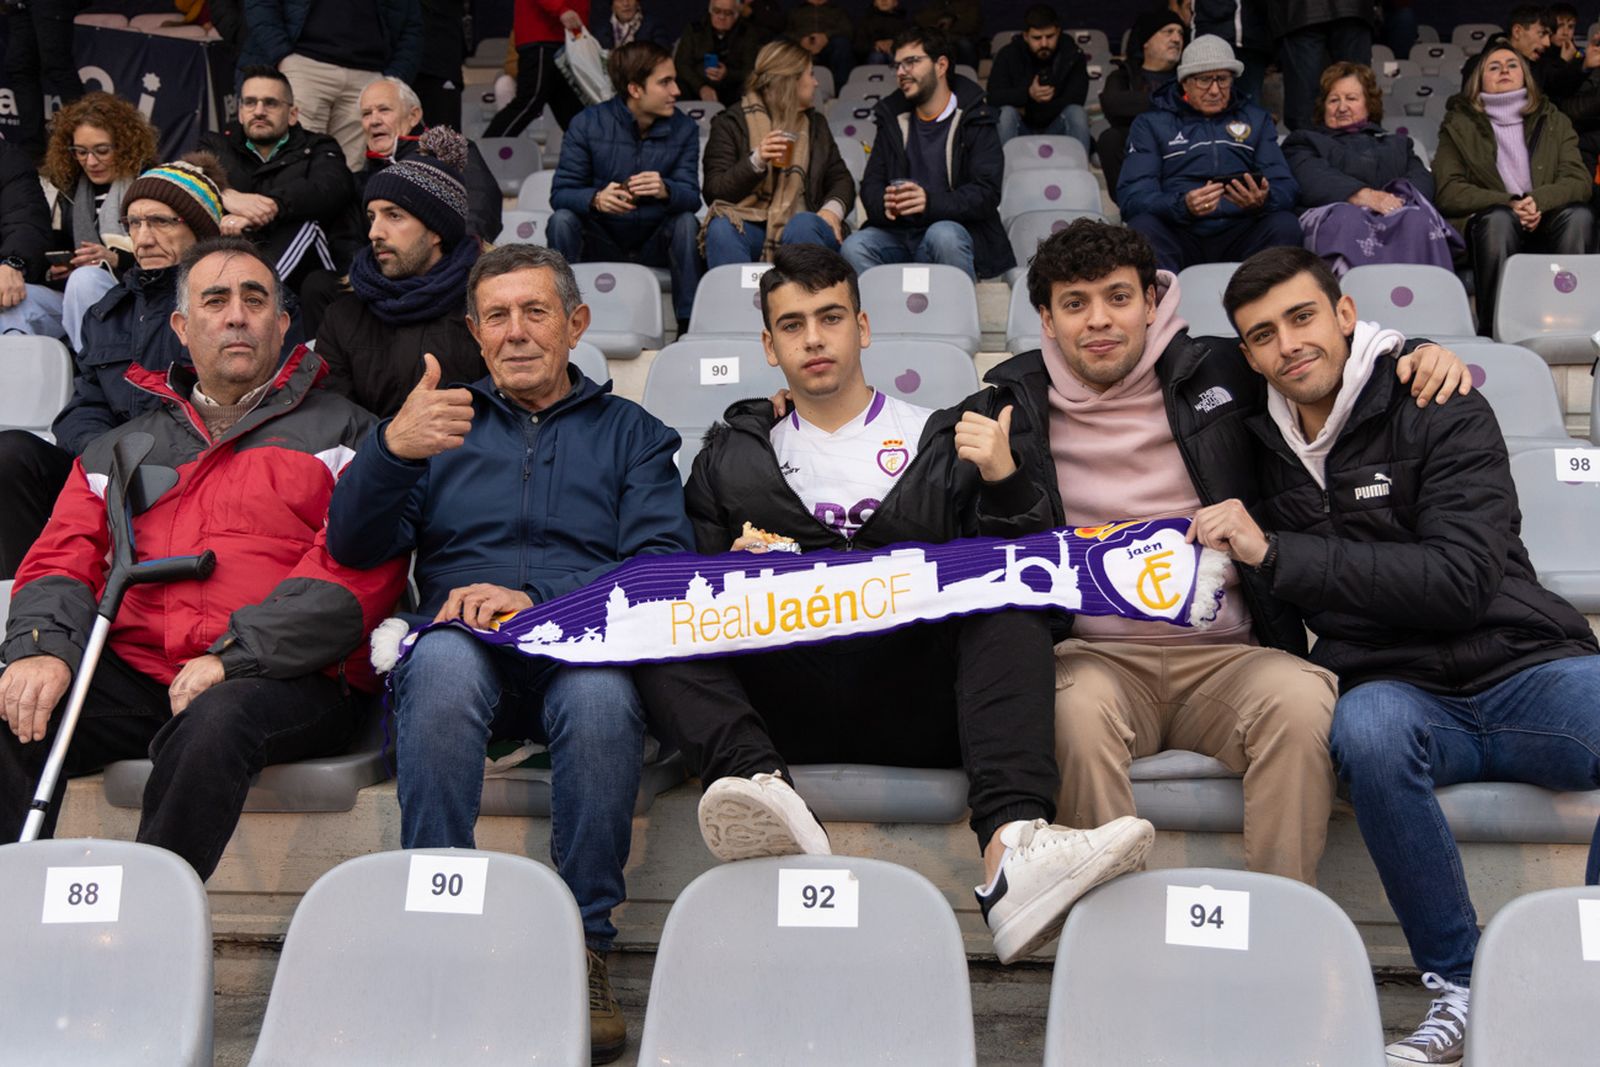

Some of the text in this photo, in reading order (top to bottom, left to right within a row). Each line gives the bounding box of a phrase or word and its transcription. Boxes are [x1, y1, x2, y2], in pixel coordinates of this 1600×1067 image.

[751, 272, 764, 282] 9
[712, 365, 728, 376] 90
[1569, 457, 1591, 471] 98
[1355, 483, 1390, 500] PUMA
[67, 883, 99, 905] 88
[431, 873, 463, 897] 90
[802, 886, 835, 909] 92
[1190, 903, 1225, 929] 94
